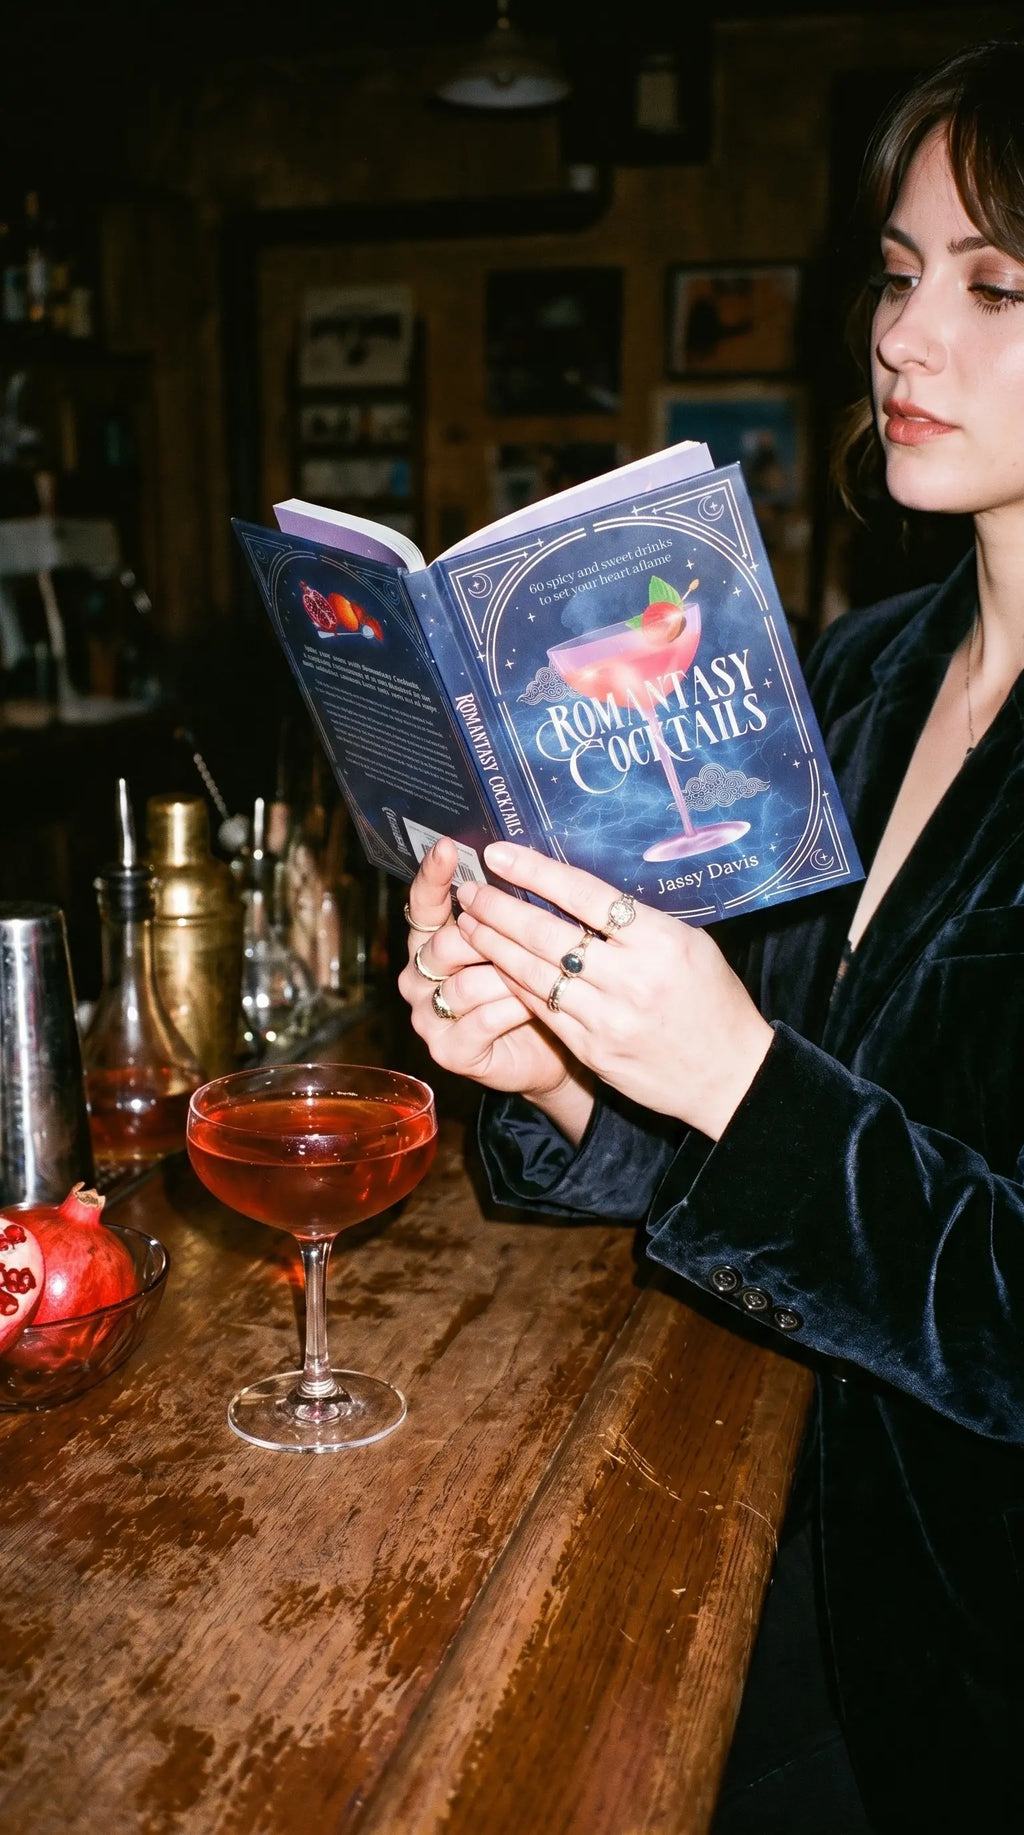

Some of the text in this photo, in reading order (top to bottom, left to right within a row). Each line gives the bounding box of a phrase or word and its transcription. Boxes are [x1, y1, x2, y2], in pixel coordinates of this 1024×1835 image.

[529, 537, 673, 594] 60 spicy and sweet drinks
[539, 553, 673, 606] to set your heart aflame
[536, 648, 755, 762] ROMANTASY
[570, 693, 767, 794] COCKTAILS
[455, 692, 524, 837] ROMANTASY COCKTAILS
[657, 854, 759, 895] Jassy Davis
